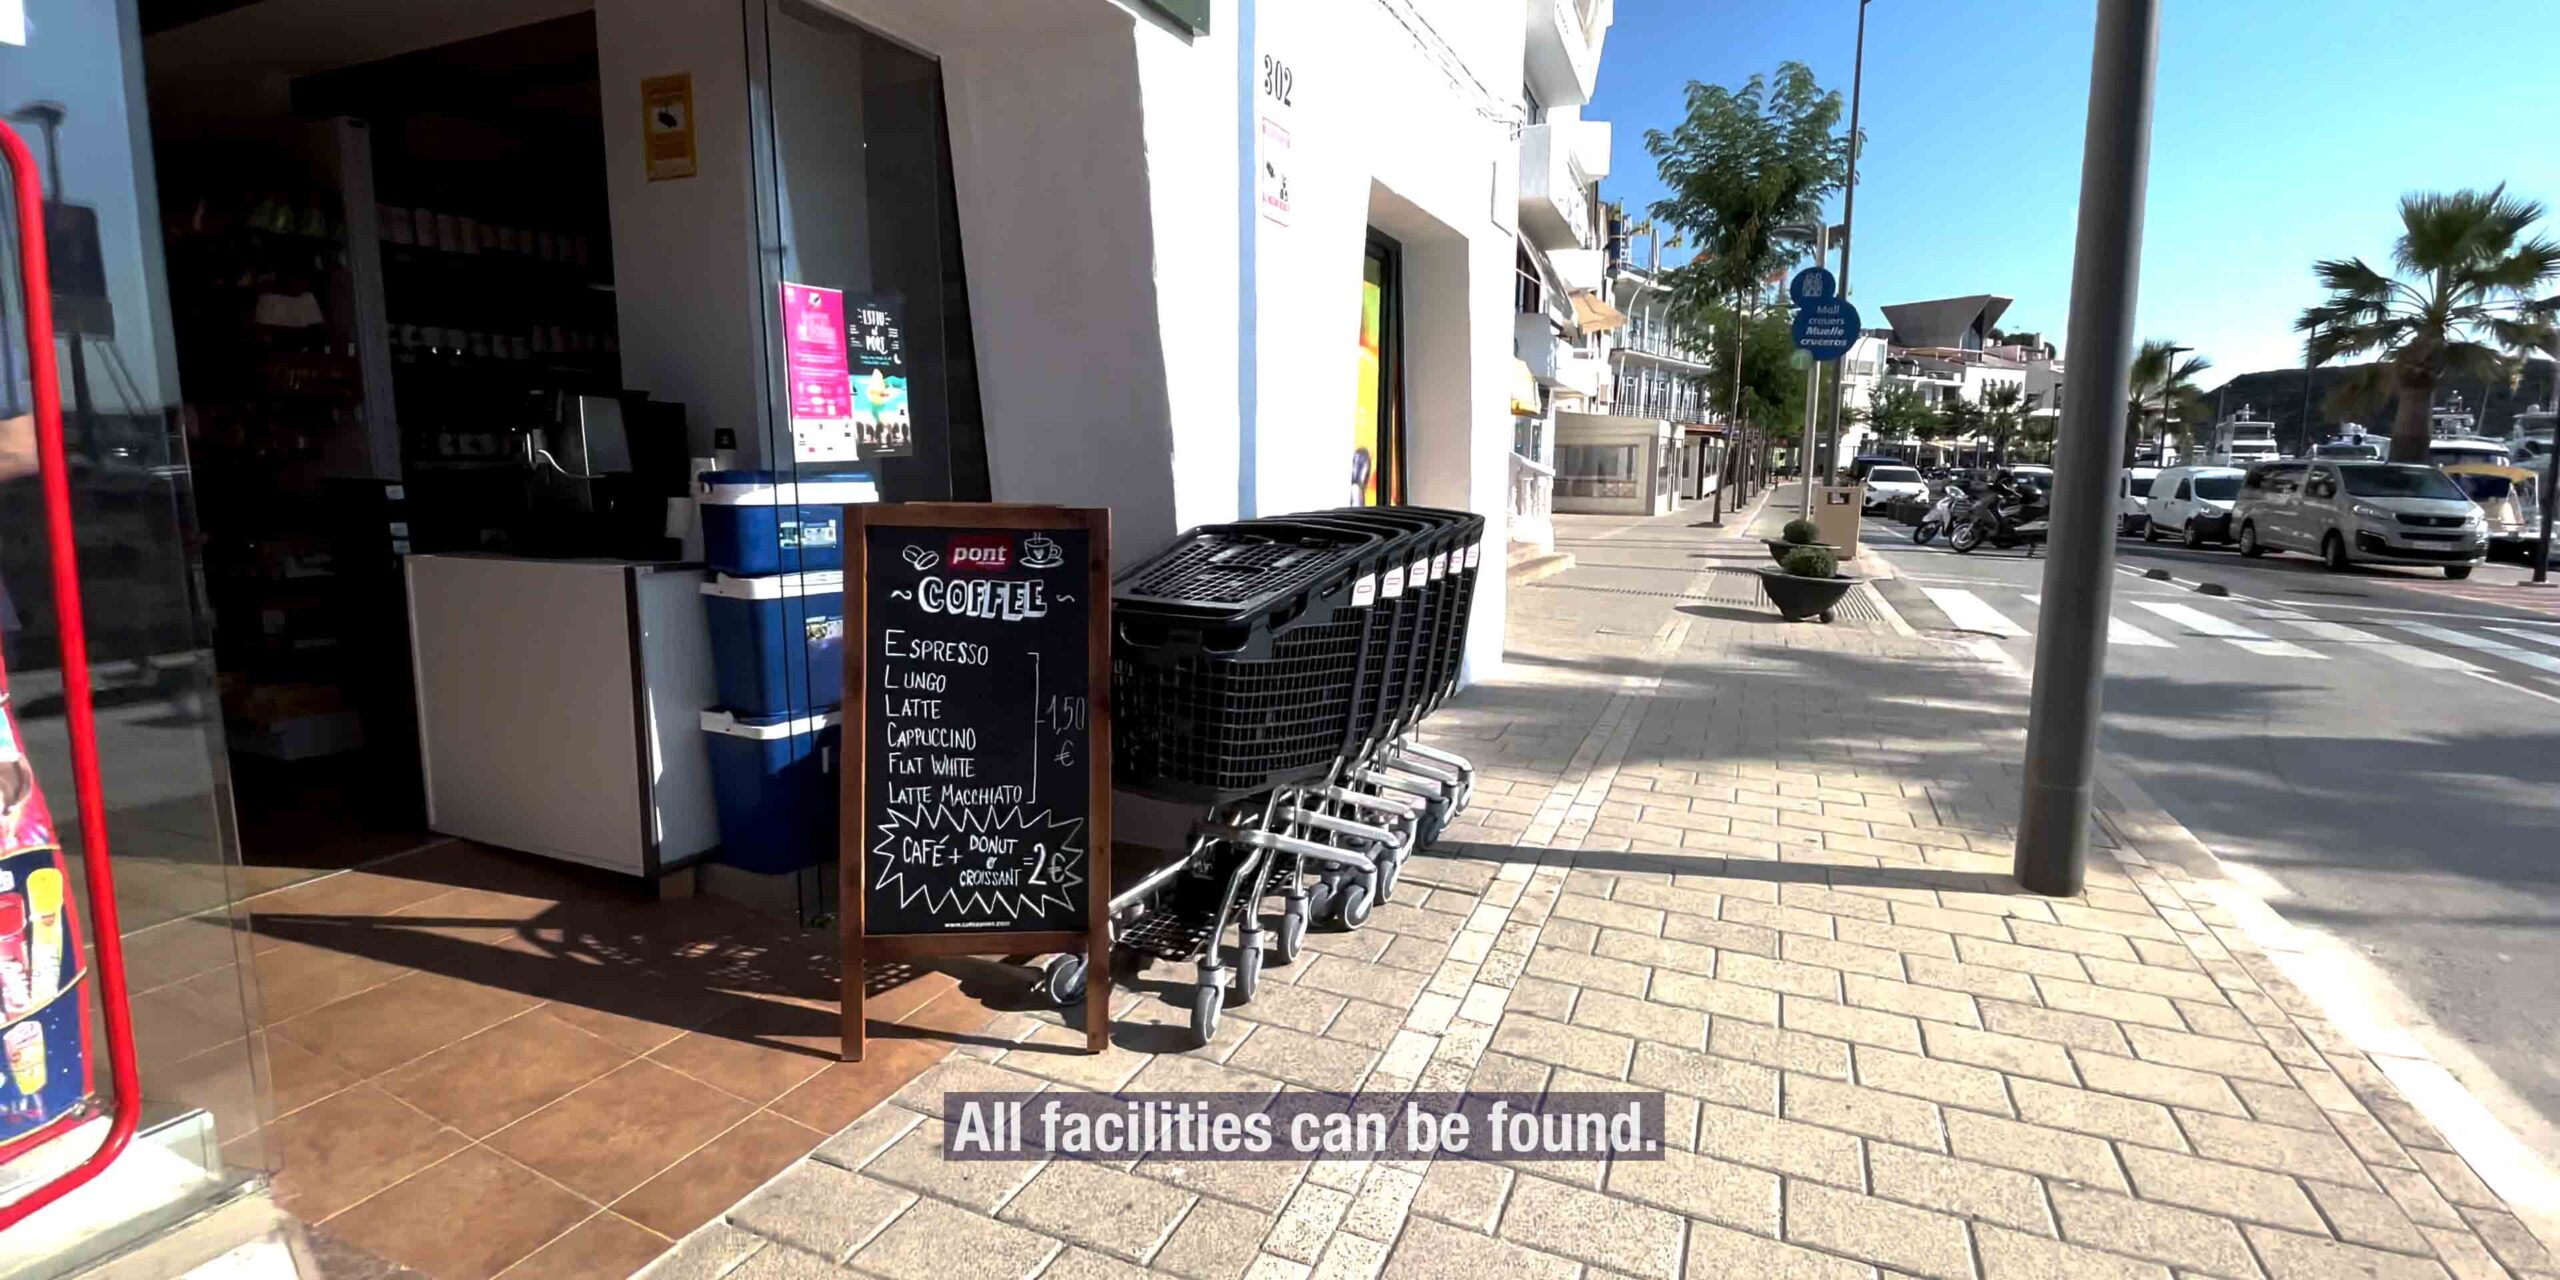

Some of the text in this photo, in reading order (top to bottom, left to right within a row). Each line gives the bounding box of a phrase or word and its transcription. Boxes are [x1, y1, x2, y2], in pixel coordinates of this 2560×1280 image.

[1264, 54, 1292, 107] 302
[1800, 337, 1848, 346] cruceros
[1806, 326, 1845, 336] Muelle
[953, 545, 1007, 565] pont
[918, 576, 1048, 621] COFFEE
[1045, 697, 1085, 735] 1,50
[887, 721, 977, 751] CAPPUCCINO
[889, 752, 976, 778] FLAT WHITE
[1054, 740, 1075, 767] €
[888, 781, 1023, 807] LATTE MACCHIATO
[902, 834, 950, 867] CAFÉ
[969, 834, 1019, 855] DONUT
[959, 867, 1023, 887] CROISSANT
